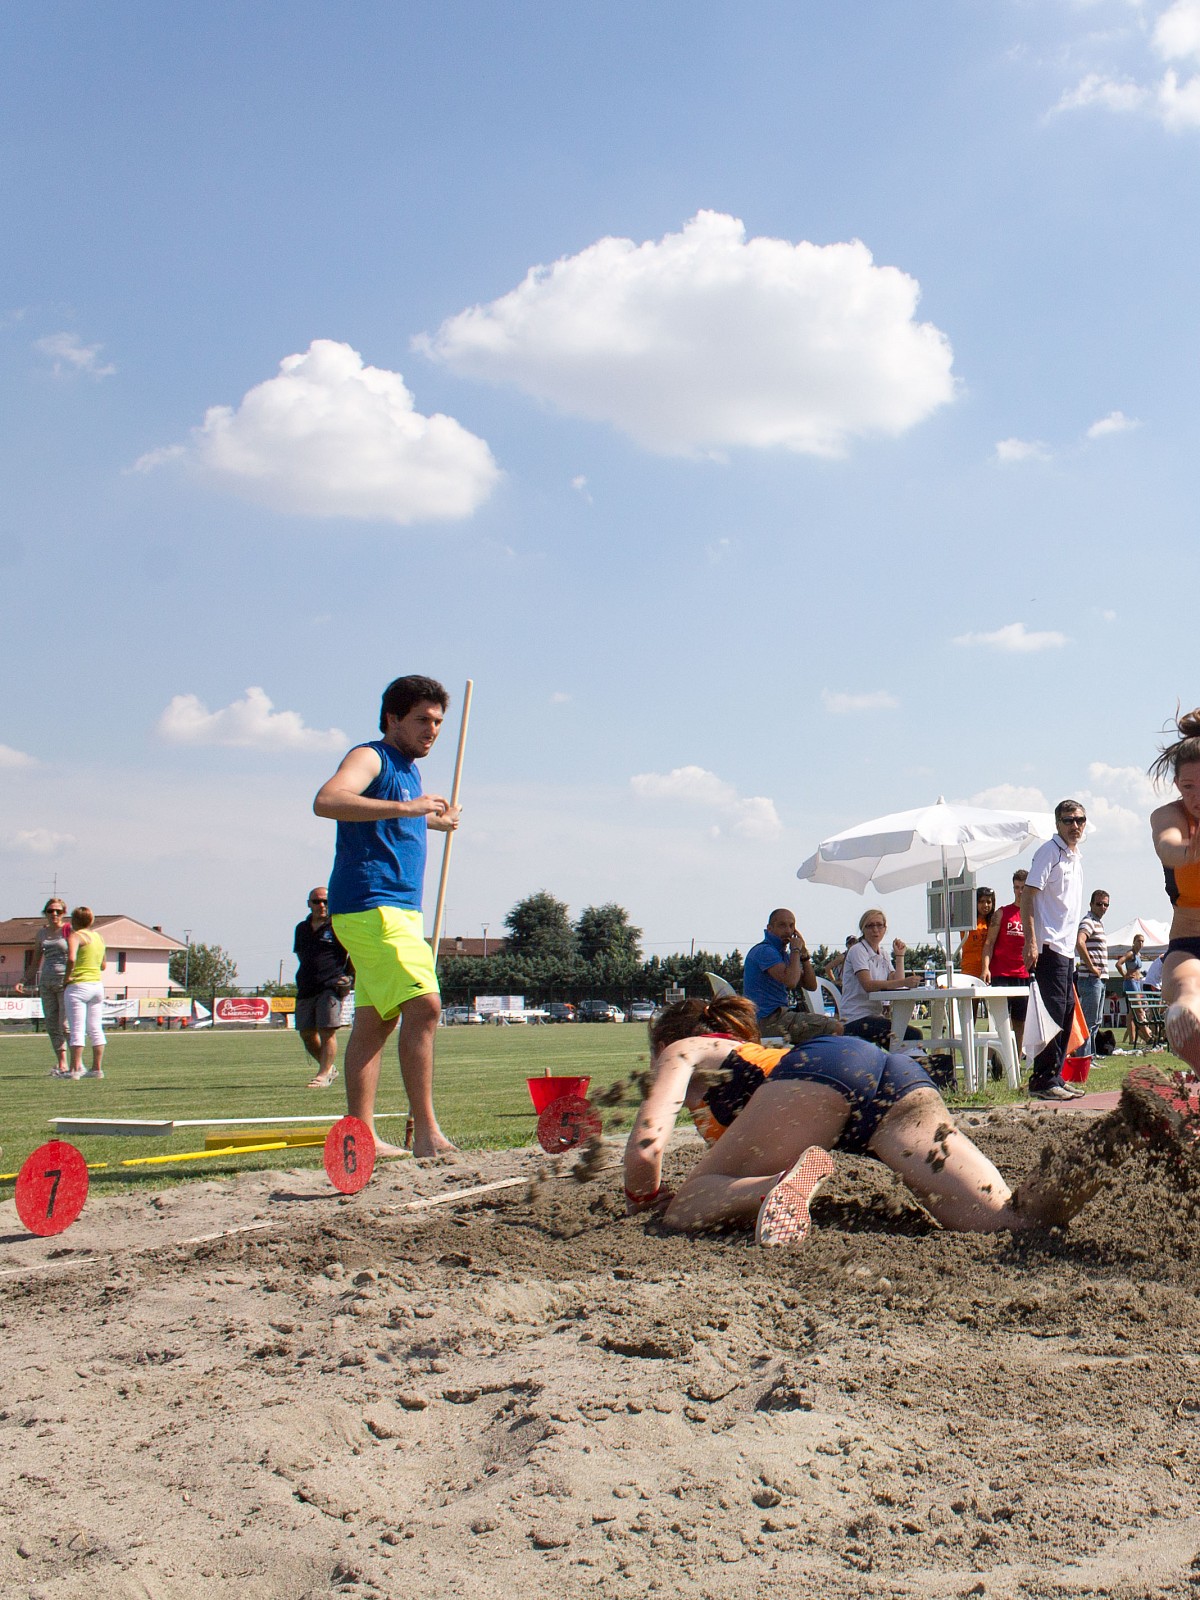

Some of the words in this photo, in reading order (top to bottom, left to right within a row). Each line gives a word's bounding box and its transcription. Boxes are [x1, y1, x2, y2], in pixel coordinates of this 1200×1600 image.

[559, 1112, 581, 1145] 5
[343, 1134, 357, 1174] 6
[43, 1169, 62, 1219] 7
